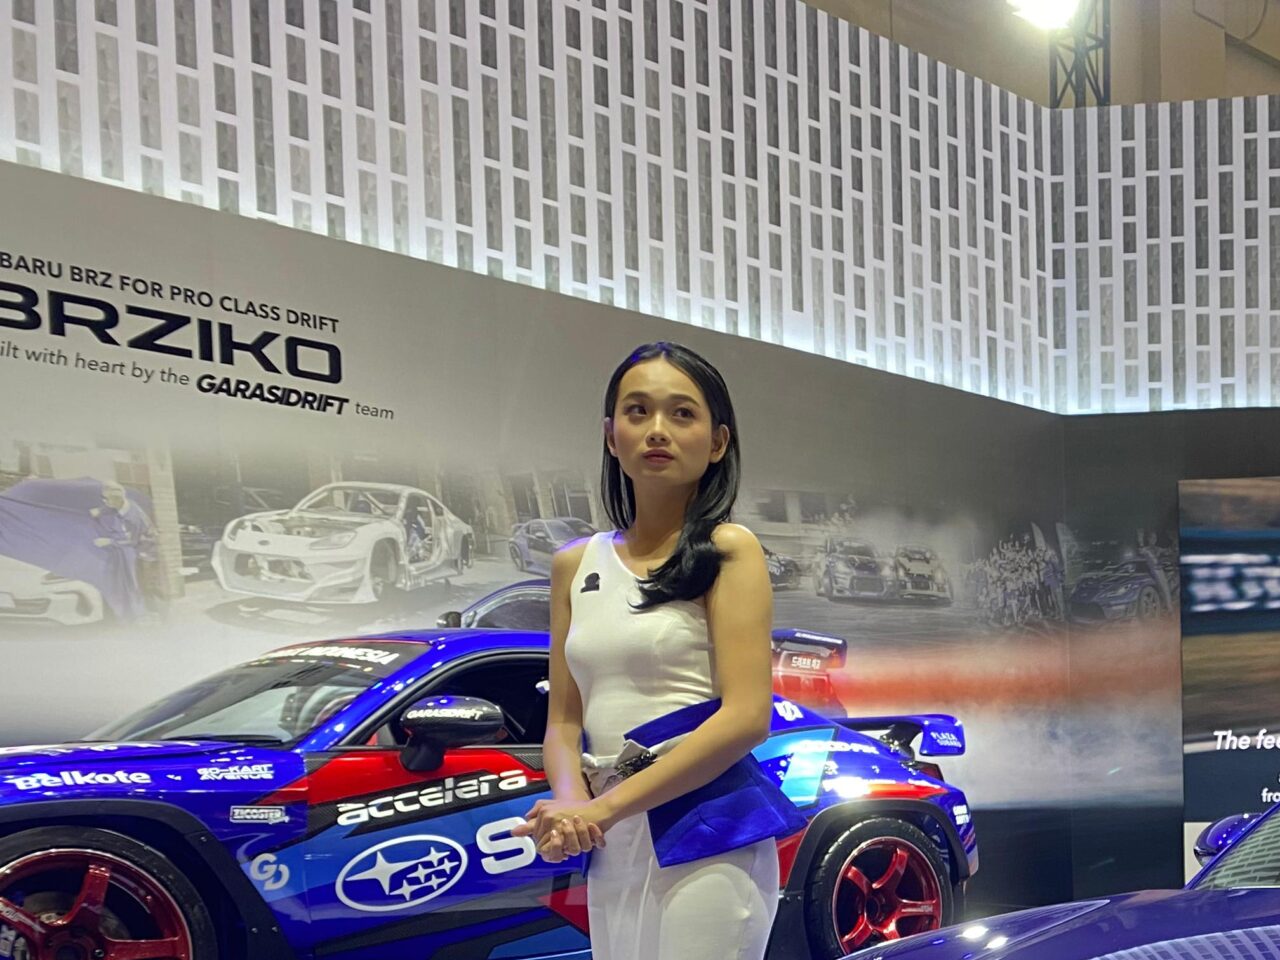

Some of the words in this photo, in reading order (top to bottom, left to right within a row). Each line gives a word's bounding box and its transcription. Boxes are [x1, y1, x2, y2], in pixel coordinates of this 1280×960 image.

[0, 280, 343, 385] BRZIKO
[70, 264, 113, 290] BRZ
[119, 274, 163, 299] FOR
[169, 284, 214, 307] PRO
[219, 295, 281, 322] CLASS
[285, 308, 340, 334] DRIFT
[24, 347, 68, 367] with
[75, 352, 125, 377] heart
[131, 358, 155, 384] by
[160, 367, 191, 387] the
[196, 373, 351, 416] GARASIDRIFT
[354, 401, 396, 421] team
[1212, 729, 1251, 751] The
[336, 769, 528, 827] accelera
